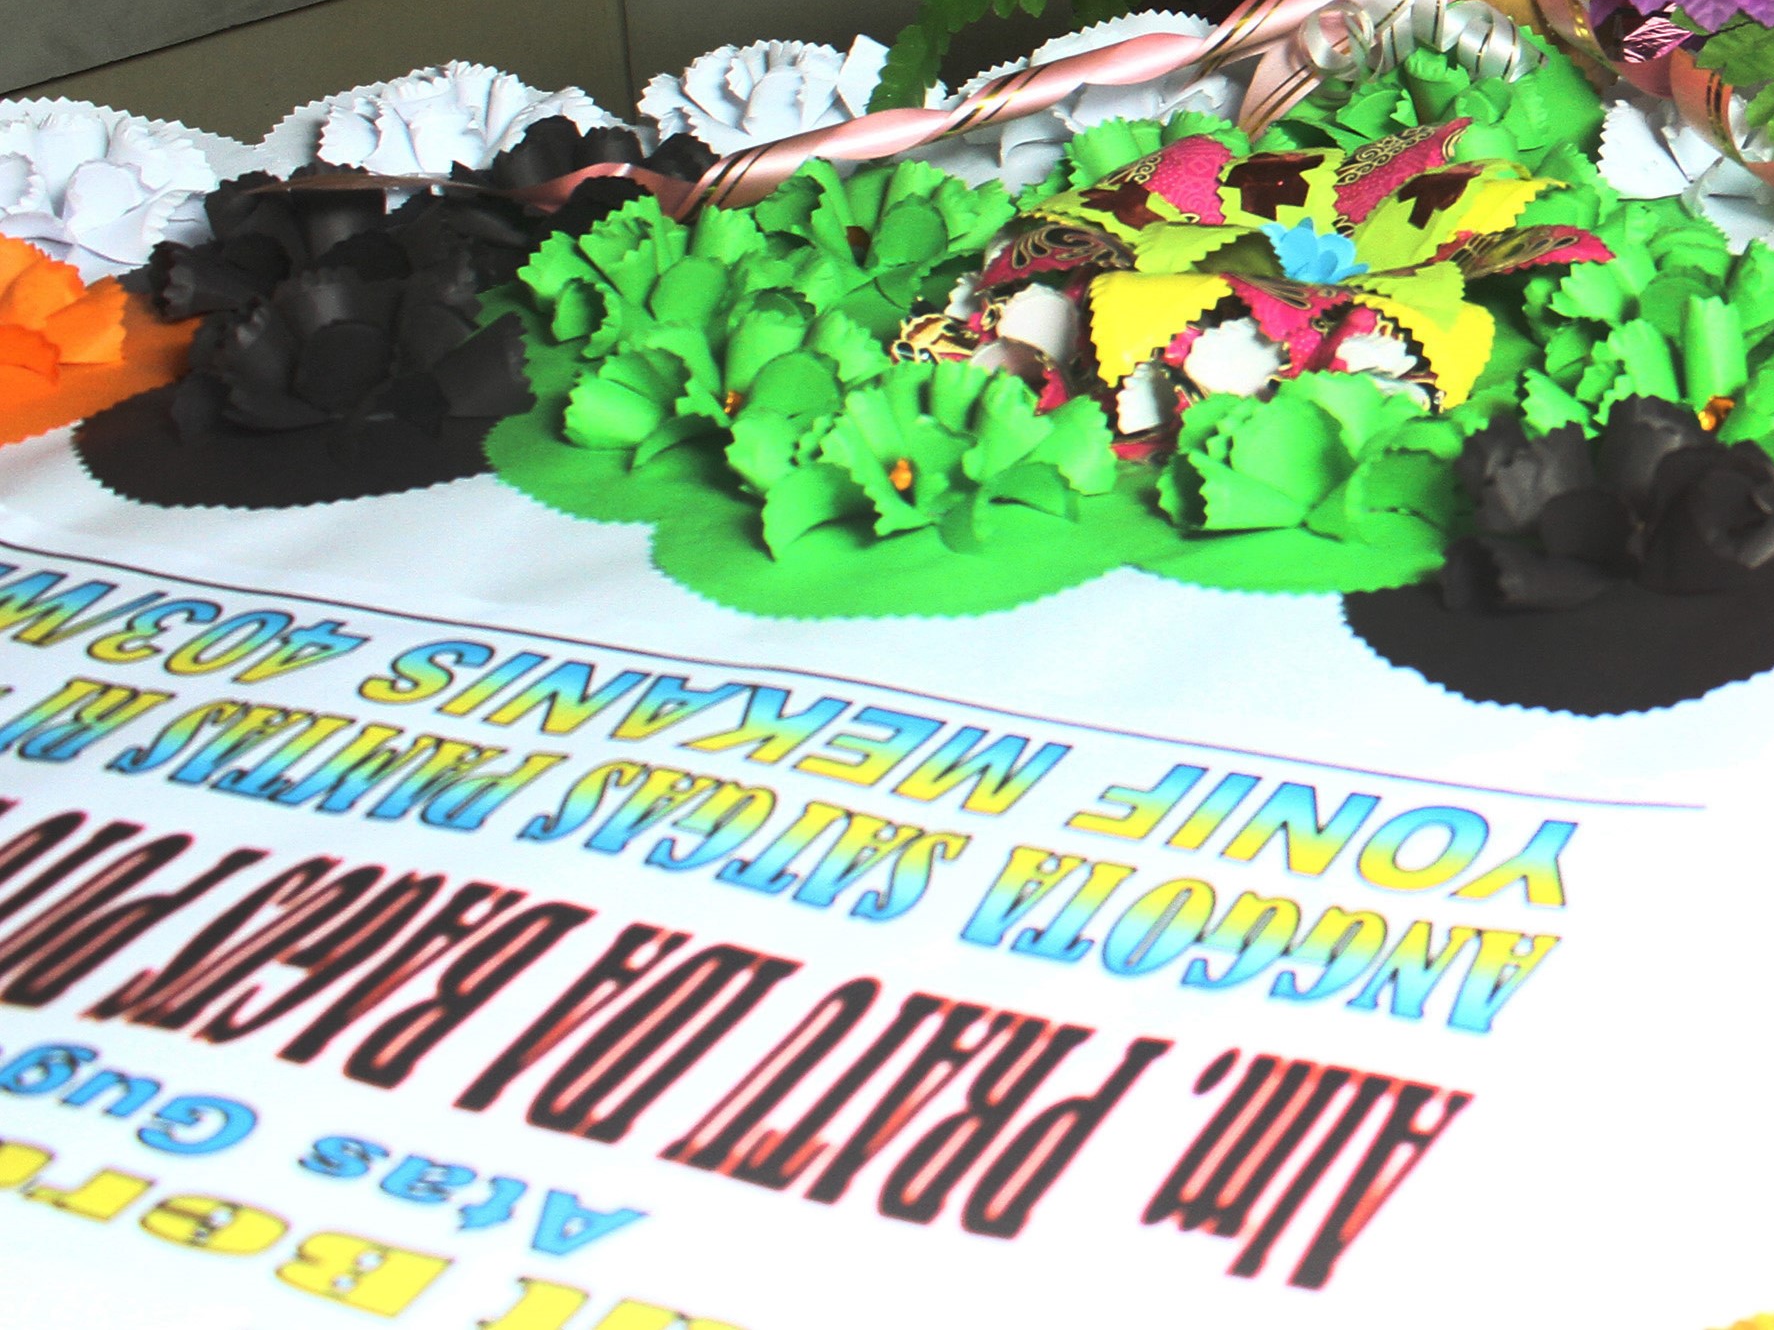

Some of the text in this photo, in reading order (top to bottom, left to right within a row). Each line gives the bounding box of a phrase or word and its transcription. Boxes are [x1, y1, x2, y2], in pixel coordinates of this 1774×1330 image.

[0, 560, 1579, 908] YONIF MEKANIS 403/W
[103, 697, 570, 833] PAMTAS
[514, 757, 972, 925] SATGAS
[451, 923, 803, 1145] IDA
[957, 843, 1561, 1036] ANGGOTA
[297, 1134, 649, 1258] Atas
[655, 976, 1175, 1241] PRATU
[1140, 1047, 1473, 1292] Alm.
[0, 1137, 454, 1319] Ber
